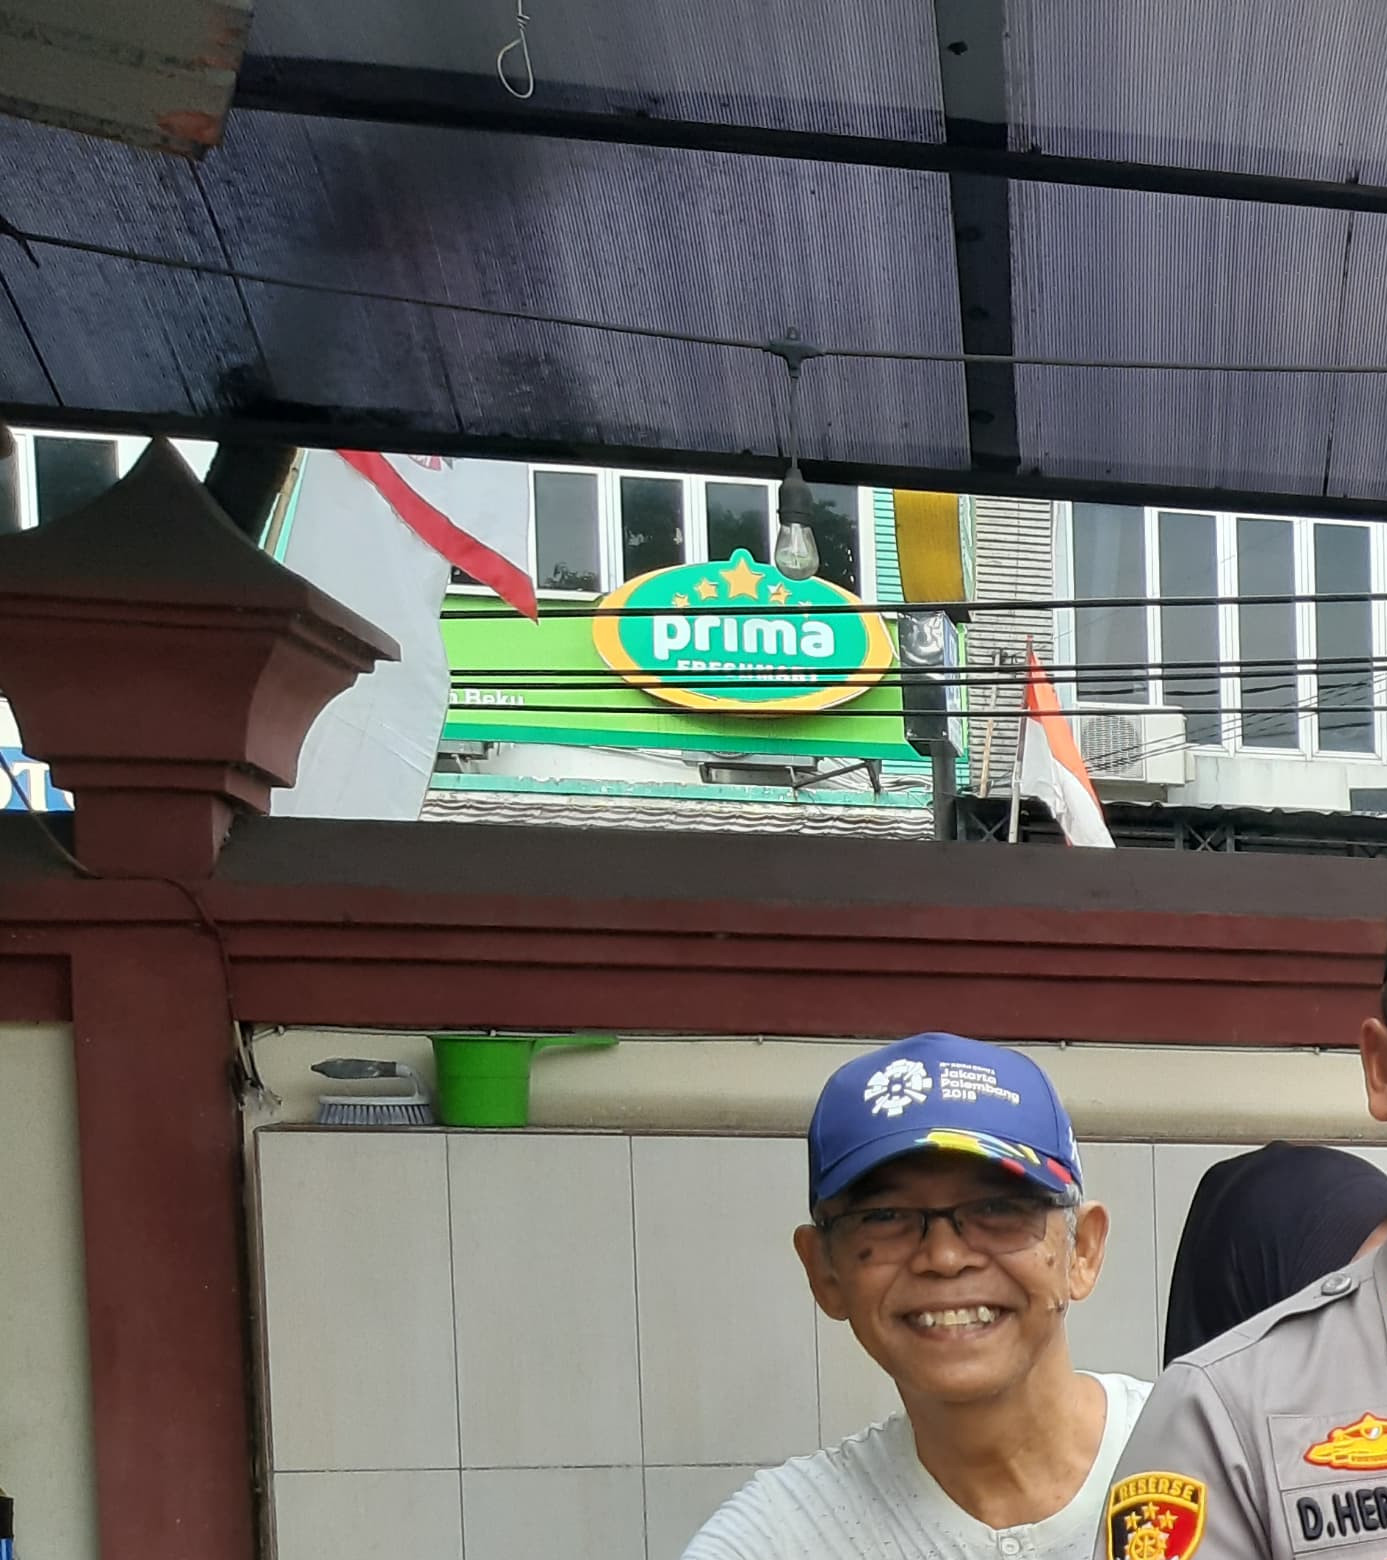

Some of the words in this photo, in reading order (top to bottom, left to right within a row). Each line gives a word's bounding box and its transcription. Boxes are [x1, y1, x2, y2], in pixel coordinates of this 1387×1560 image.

[652, 613, 836, 660] prima
[464, 688, 526, 705] Beku
[940, 1068, 997, 1086] Jakarta
[940, 1078, 1020, 1104] Palembang
[942, 1089, 978, 1101] 2018
[1119, 1477, 1195, 1501] RESERSE
